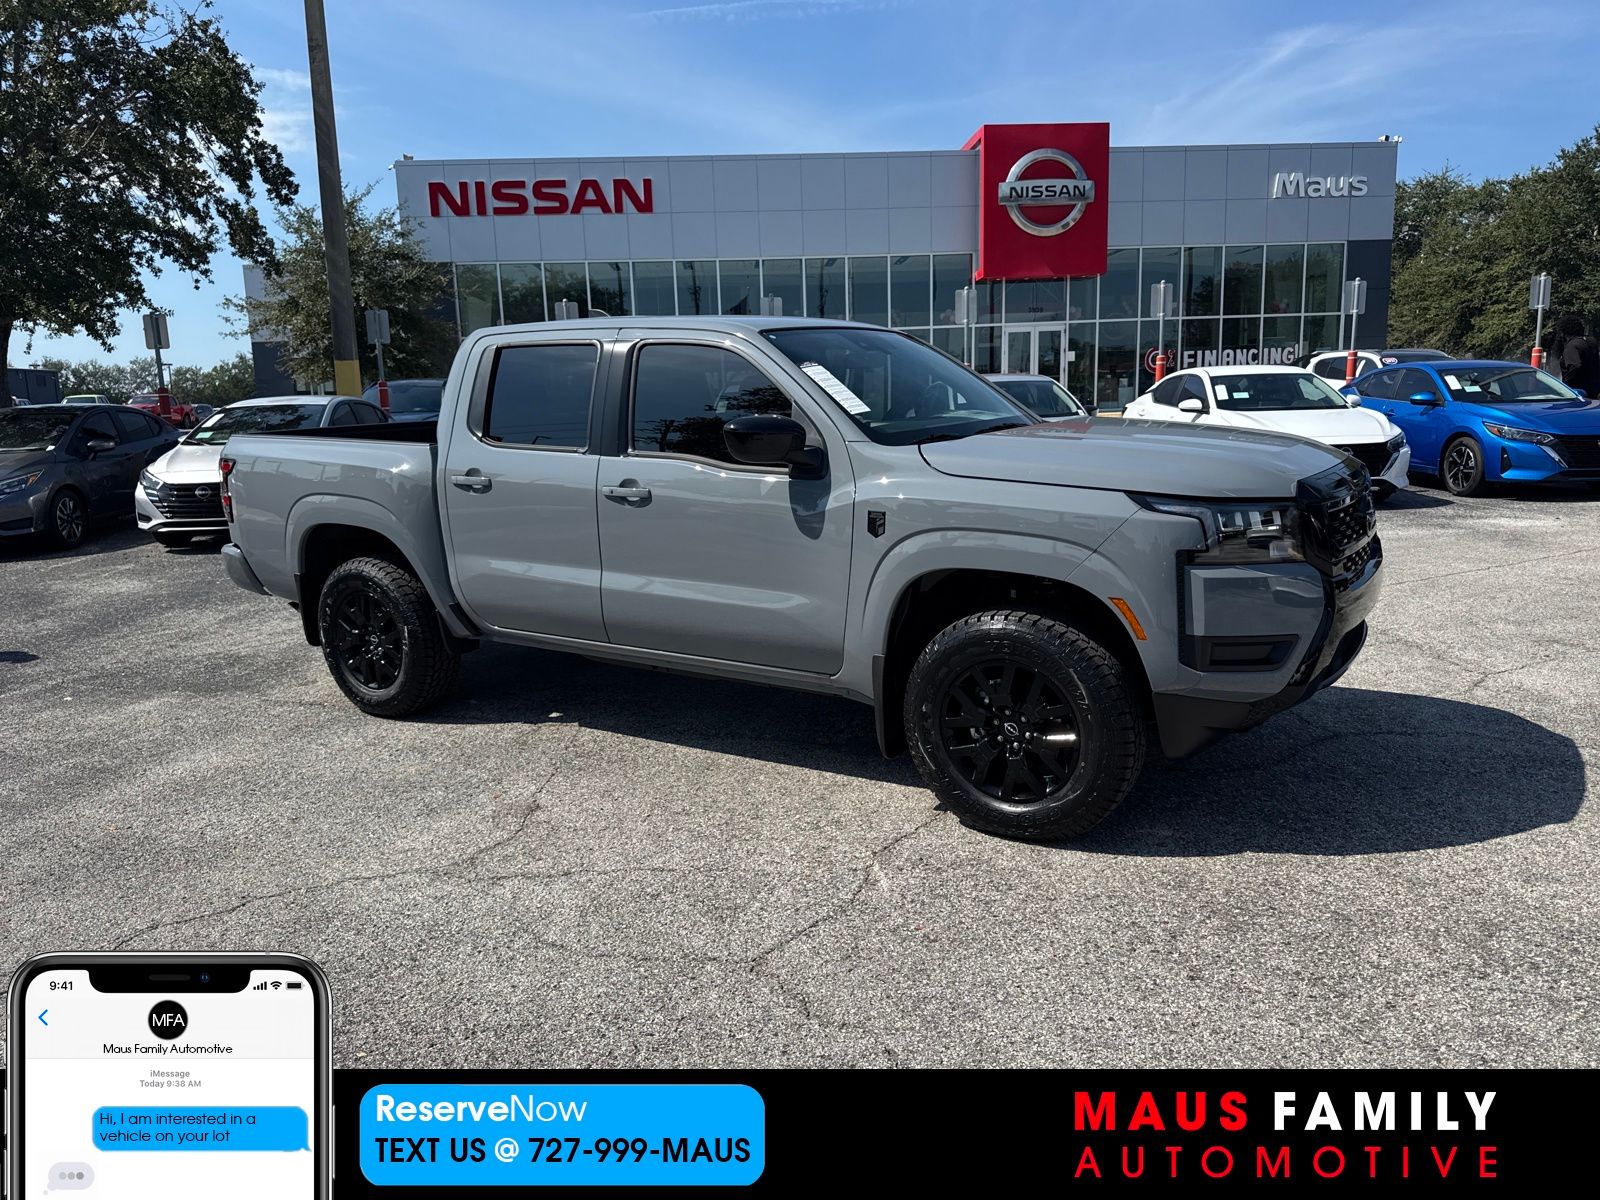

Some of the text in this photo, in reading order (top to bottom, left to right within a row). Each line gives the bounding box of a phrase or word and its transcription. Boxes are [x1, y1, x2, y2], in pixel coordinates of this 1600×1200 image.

[429, 178, 653, 217] NISSAN
[1009, 184, 1086, 199] NISSAN
[1272, 171, 1368, 199] Maus
[1182, 343, 1299, 368] FINANCING!
